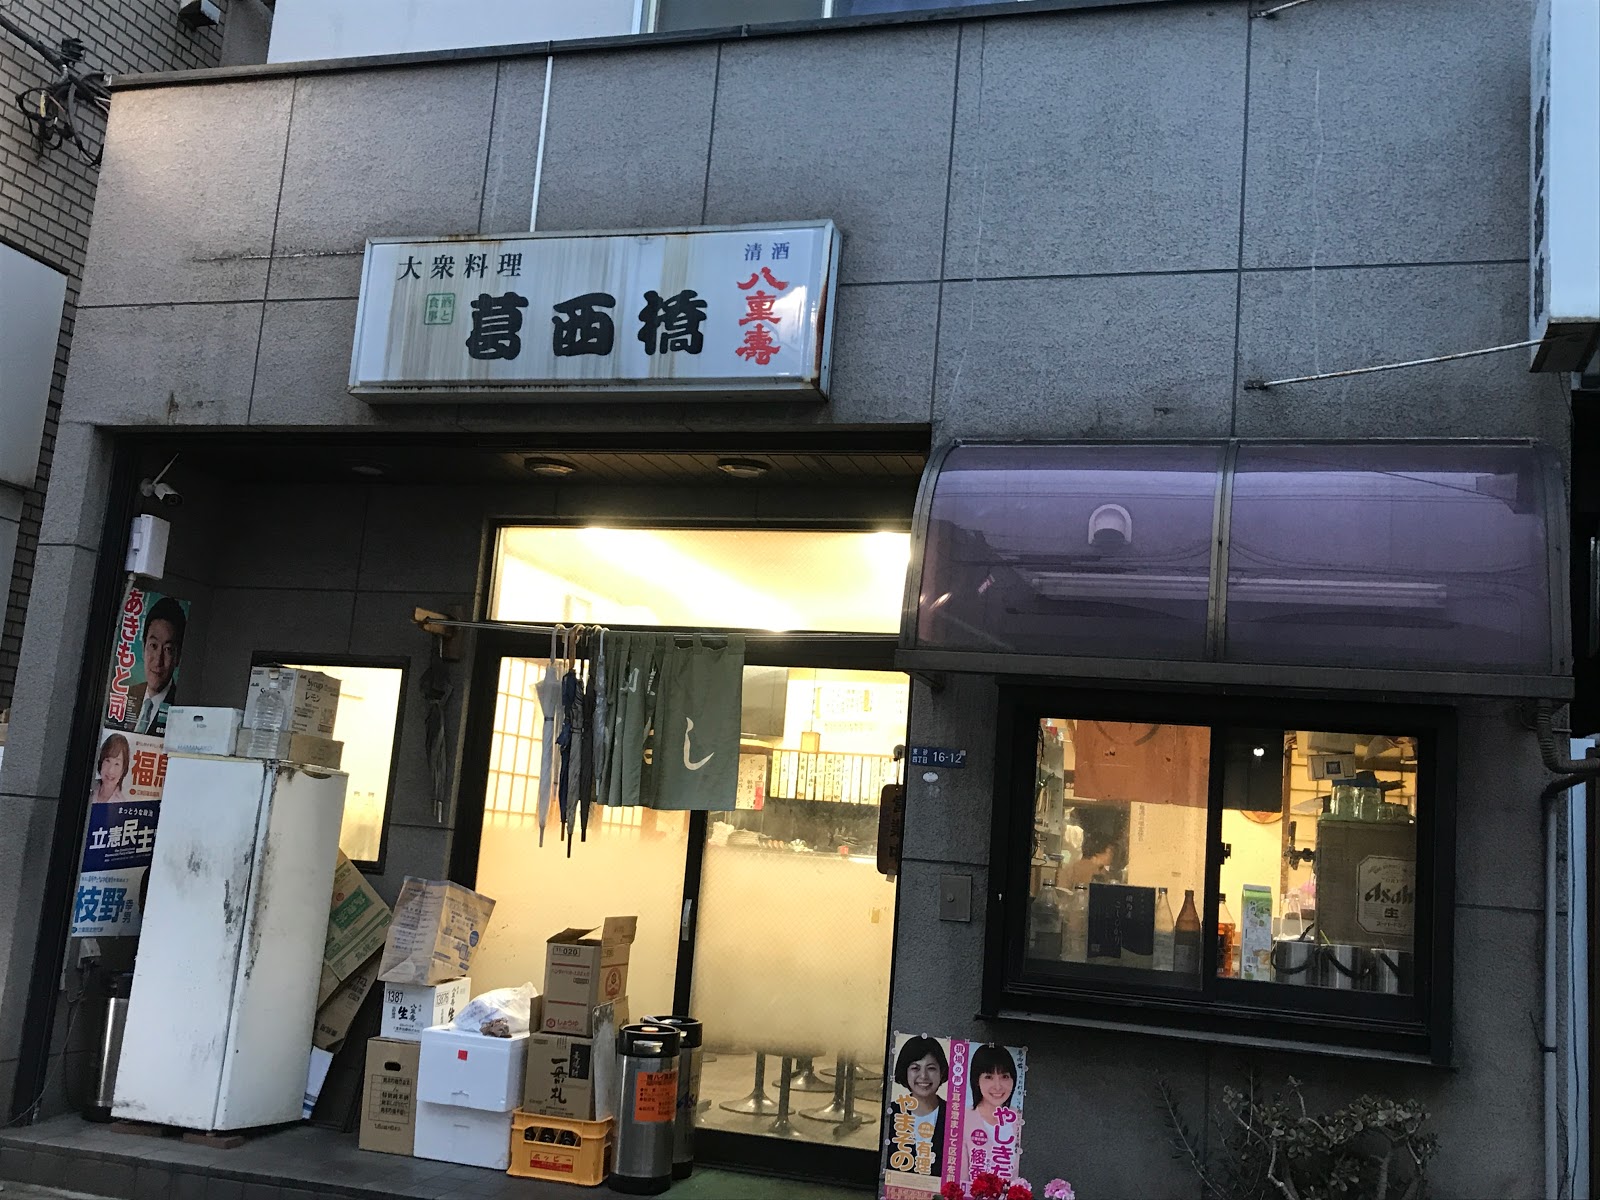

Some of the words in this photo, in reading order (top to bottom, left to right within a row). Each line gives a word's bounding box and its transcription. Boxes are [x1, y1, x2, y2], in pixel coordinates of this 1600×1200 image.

[744, 241, 790, 262] 清酒
[398, 252, 523, 281] 大衆料理
[465, 290, 708, 361] 葛西橋
[108, 588, 145, 722] あきもと司
[683, 716, 714, 771] し
[912, 748, 928, 756] 東砂
[912, 755, 928, 764] 四丁目
[933, 751, 962, 764] 16-12
[75, 886, 127, 923] 枝野
[122, 899, 134, 924] 幸男
[1384, 907, 1399, 918] 生
[563, 948, 578, 956] 020
[398, 1005, 408, 1020] 生
[557, 1018, 579, 1027] しょうゆ
[890, 1095, 918, 1171] やまぞの
[991, 1106, 1017, 1179] やしきだ
[533, 1153, 572, 1163] ホッピー
[915, 1141, 933, 1175] 有理
